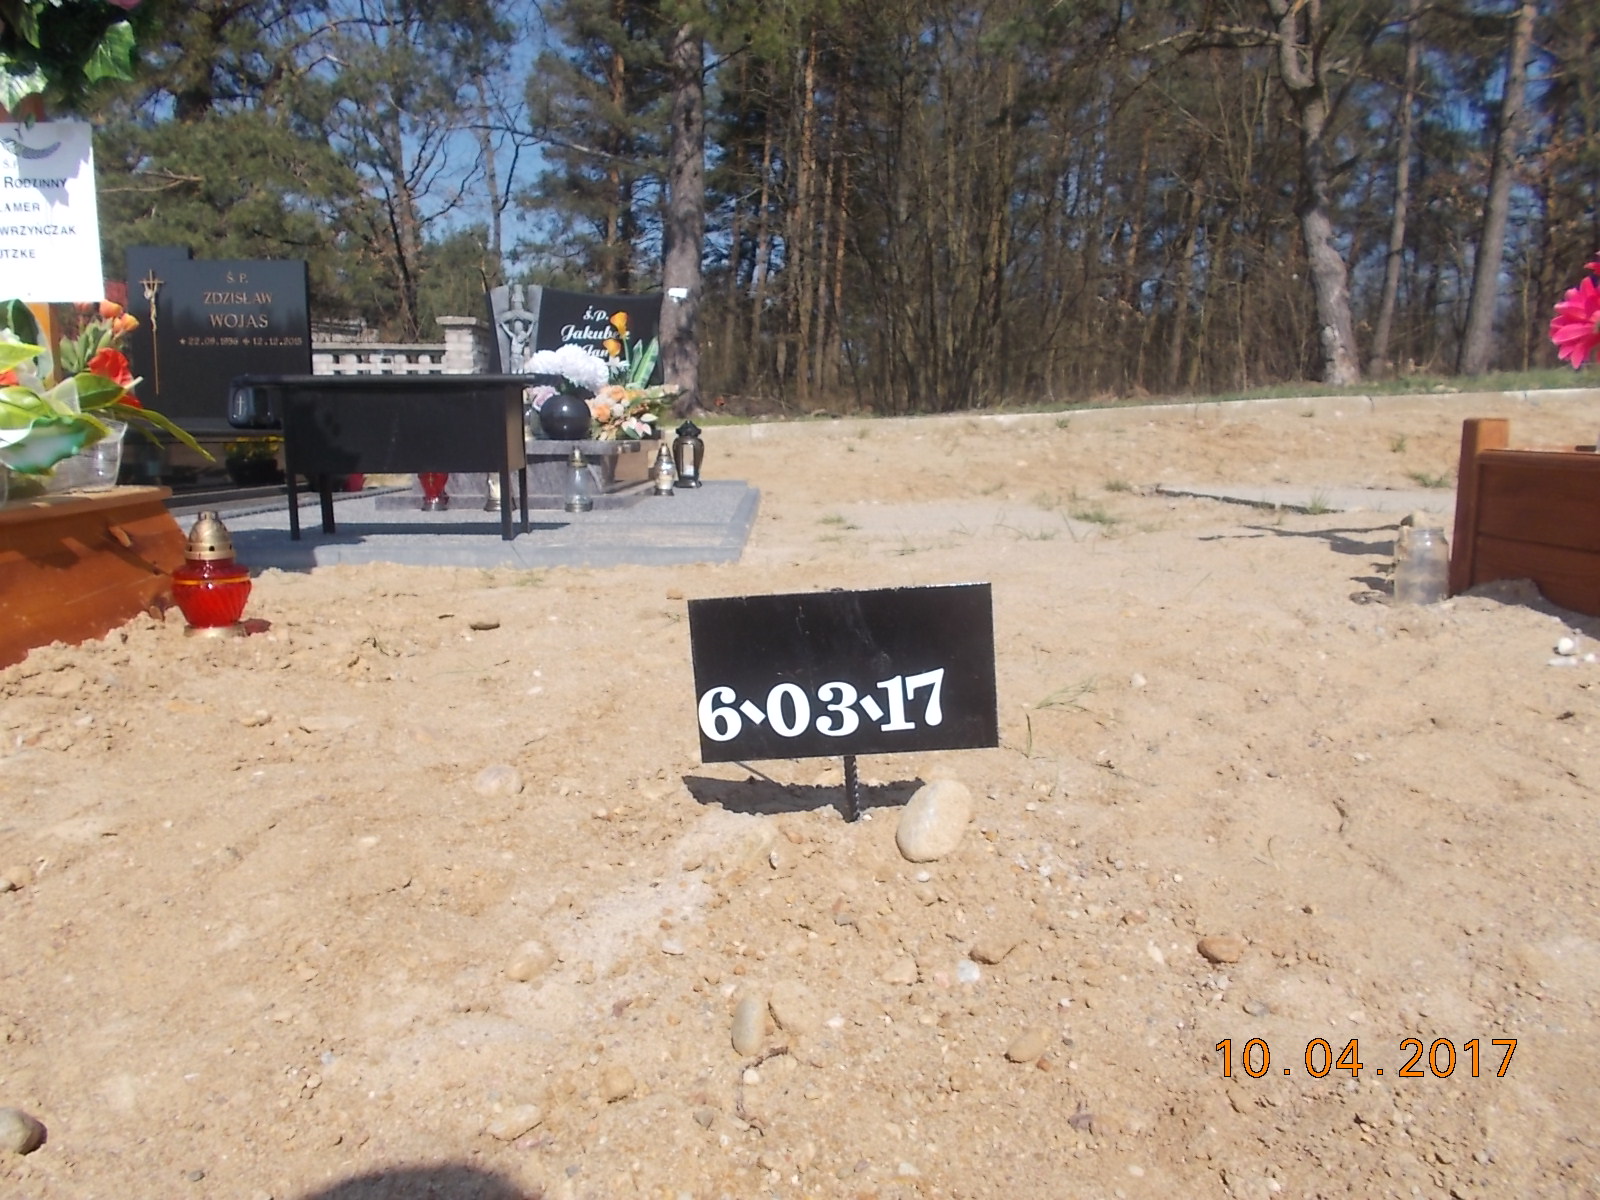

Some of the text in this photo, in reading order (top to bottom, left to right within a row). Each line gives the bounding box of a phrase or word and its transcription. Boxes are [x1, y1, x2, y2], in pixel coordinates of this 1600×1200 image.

[0, 202, 40, 212] AMER
[203, 291, 273, 305] ZDZISŁAW
[582, 305, 609, 321] ś.p.
[209, 313, 269, 329] WOJAS
